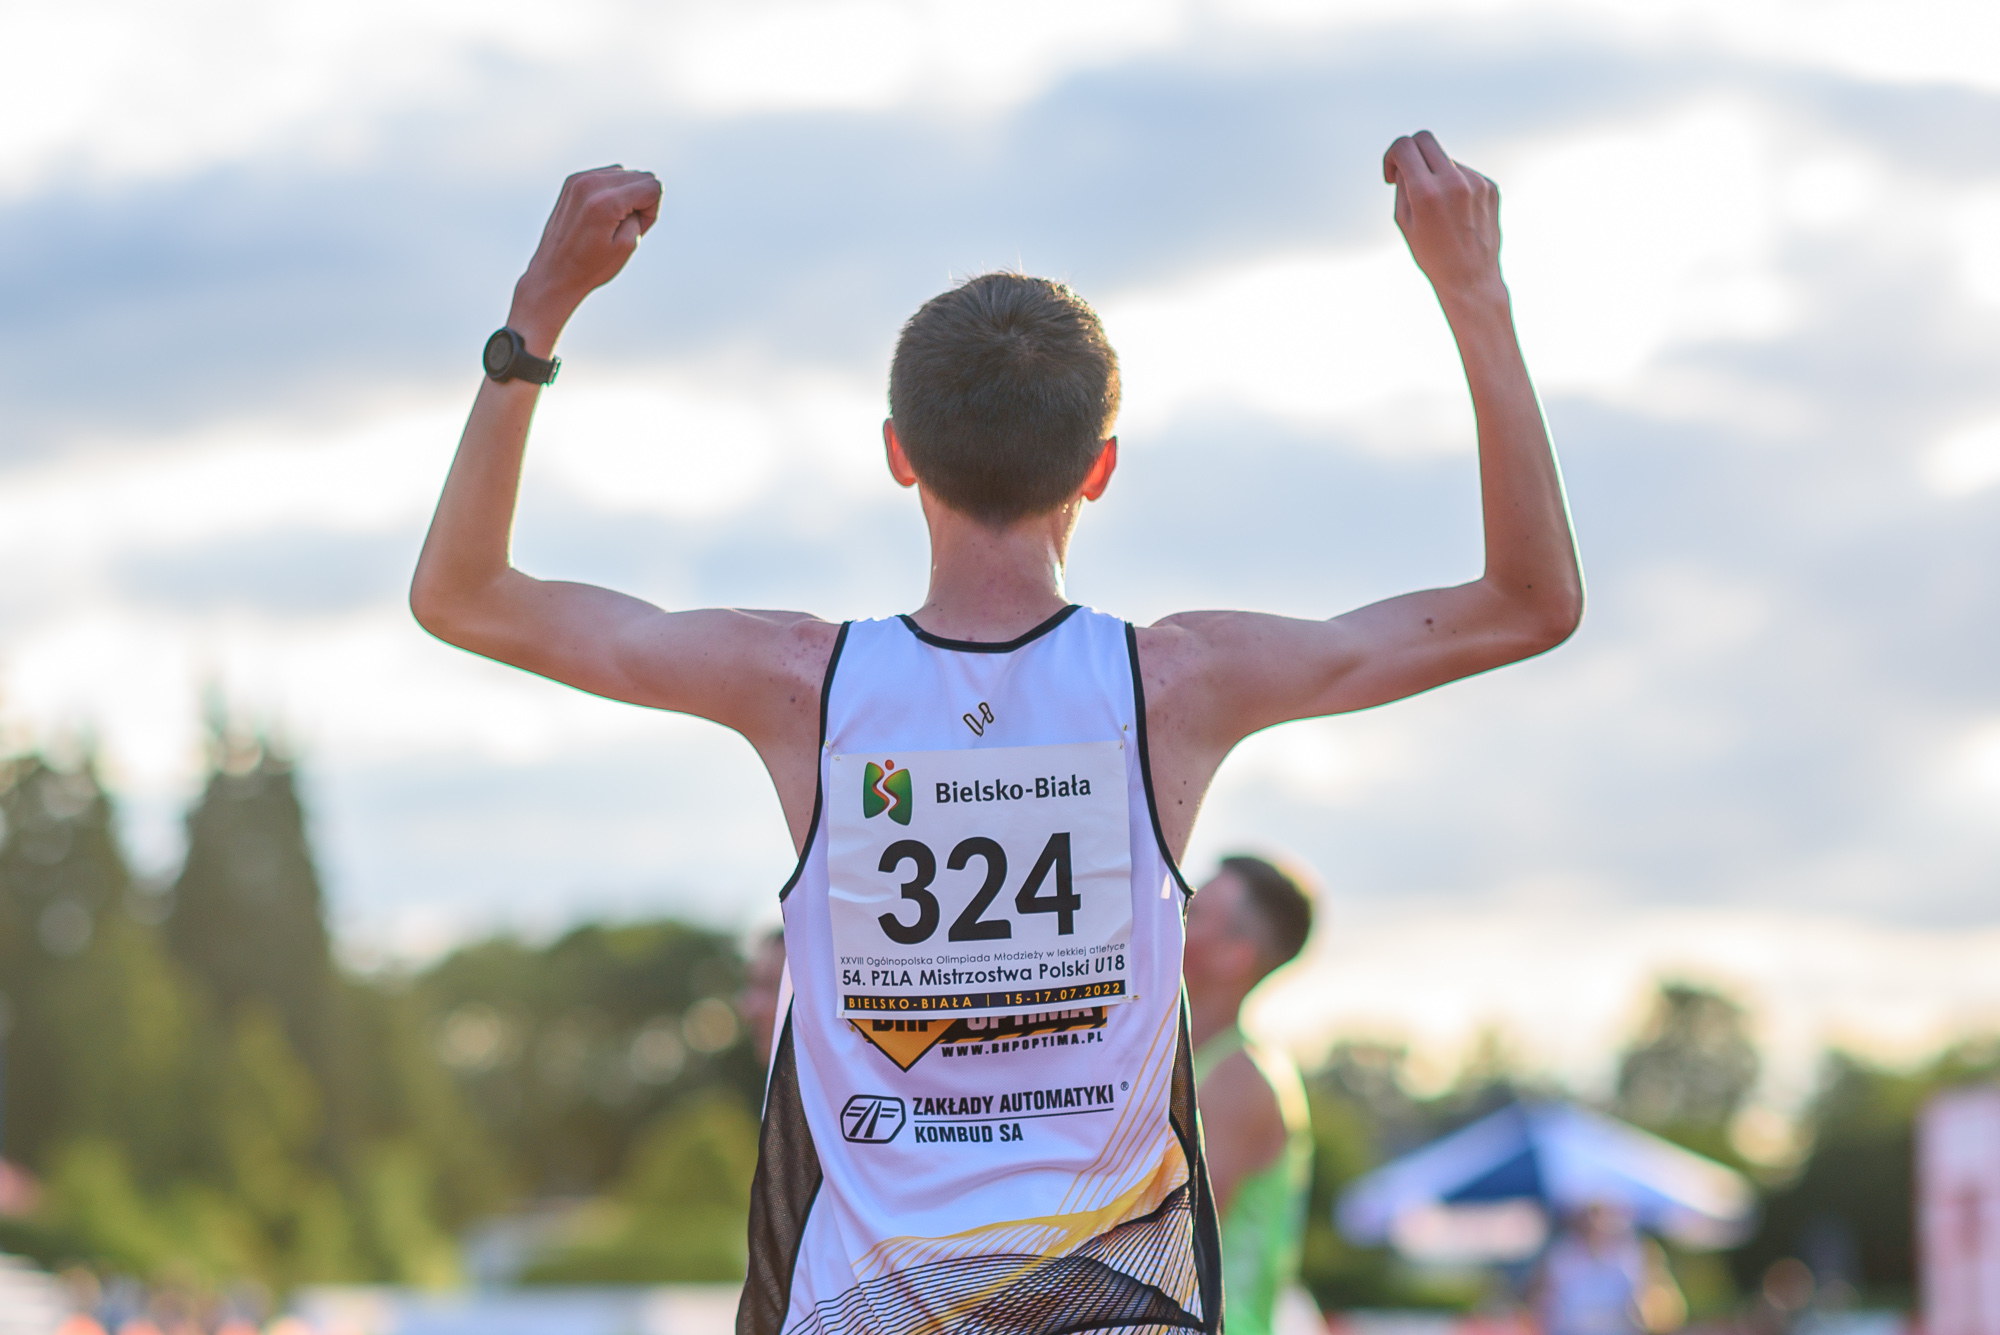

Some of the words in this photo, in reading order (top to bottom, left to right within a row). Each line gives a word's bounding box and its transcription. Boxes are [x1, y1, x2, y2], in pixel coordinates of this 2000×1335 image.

[935, 774, 1091, 804] Bielsko-Biała
[878, 832, 1081, 945] 324
[840, 956, 865, 966] XXVIII
[866, 955, 933, 967] Ogólnopolska
[936, 953, 991, 965] Olimpiada
[993, 950, 1043, 961] Młodzieży
[1046, 950, 1055, 958] w
[1057, 946, 1087, 957] lekkiej
[1089, 943, 1125, 955] atletyce
[842, 969, 867, 986] 54.
[871, 970, 913, 987] PZLA
[919, 965, 1032, 986] Mistrzostwa
[1039, 959, 1089, 980] Polski
[1094, 954, 1125, 974] U18
[848, 996, 972, 1010] BIELSKO-BIAŁA
[1005, 982, 1120, 1005] 15-17.07.2022
[941, 1031, 1103, 1057] WWW.BHPOPTIMA.PL
[912, 1096, 994, 1116] ZAKŁADY
[1000, 1084, 1114, 1113] AUTOMATYKI
[914, 1125, 993, 1143] KOMBUD
[1000, 1123, 1024, 1143] SA
